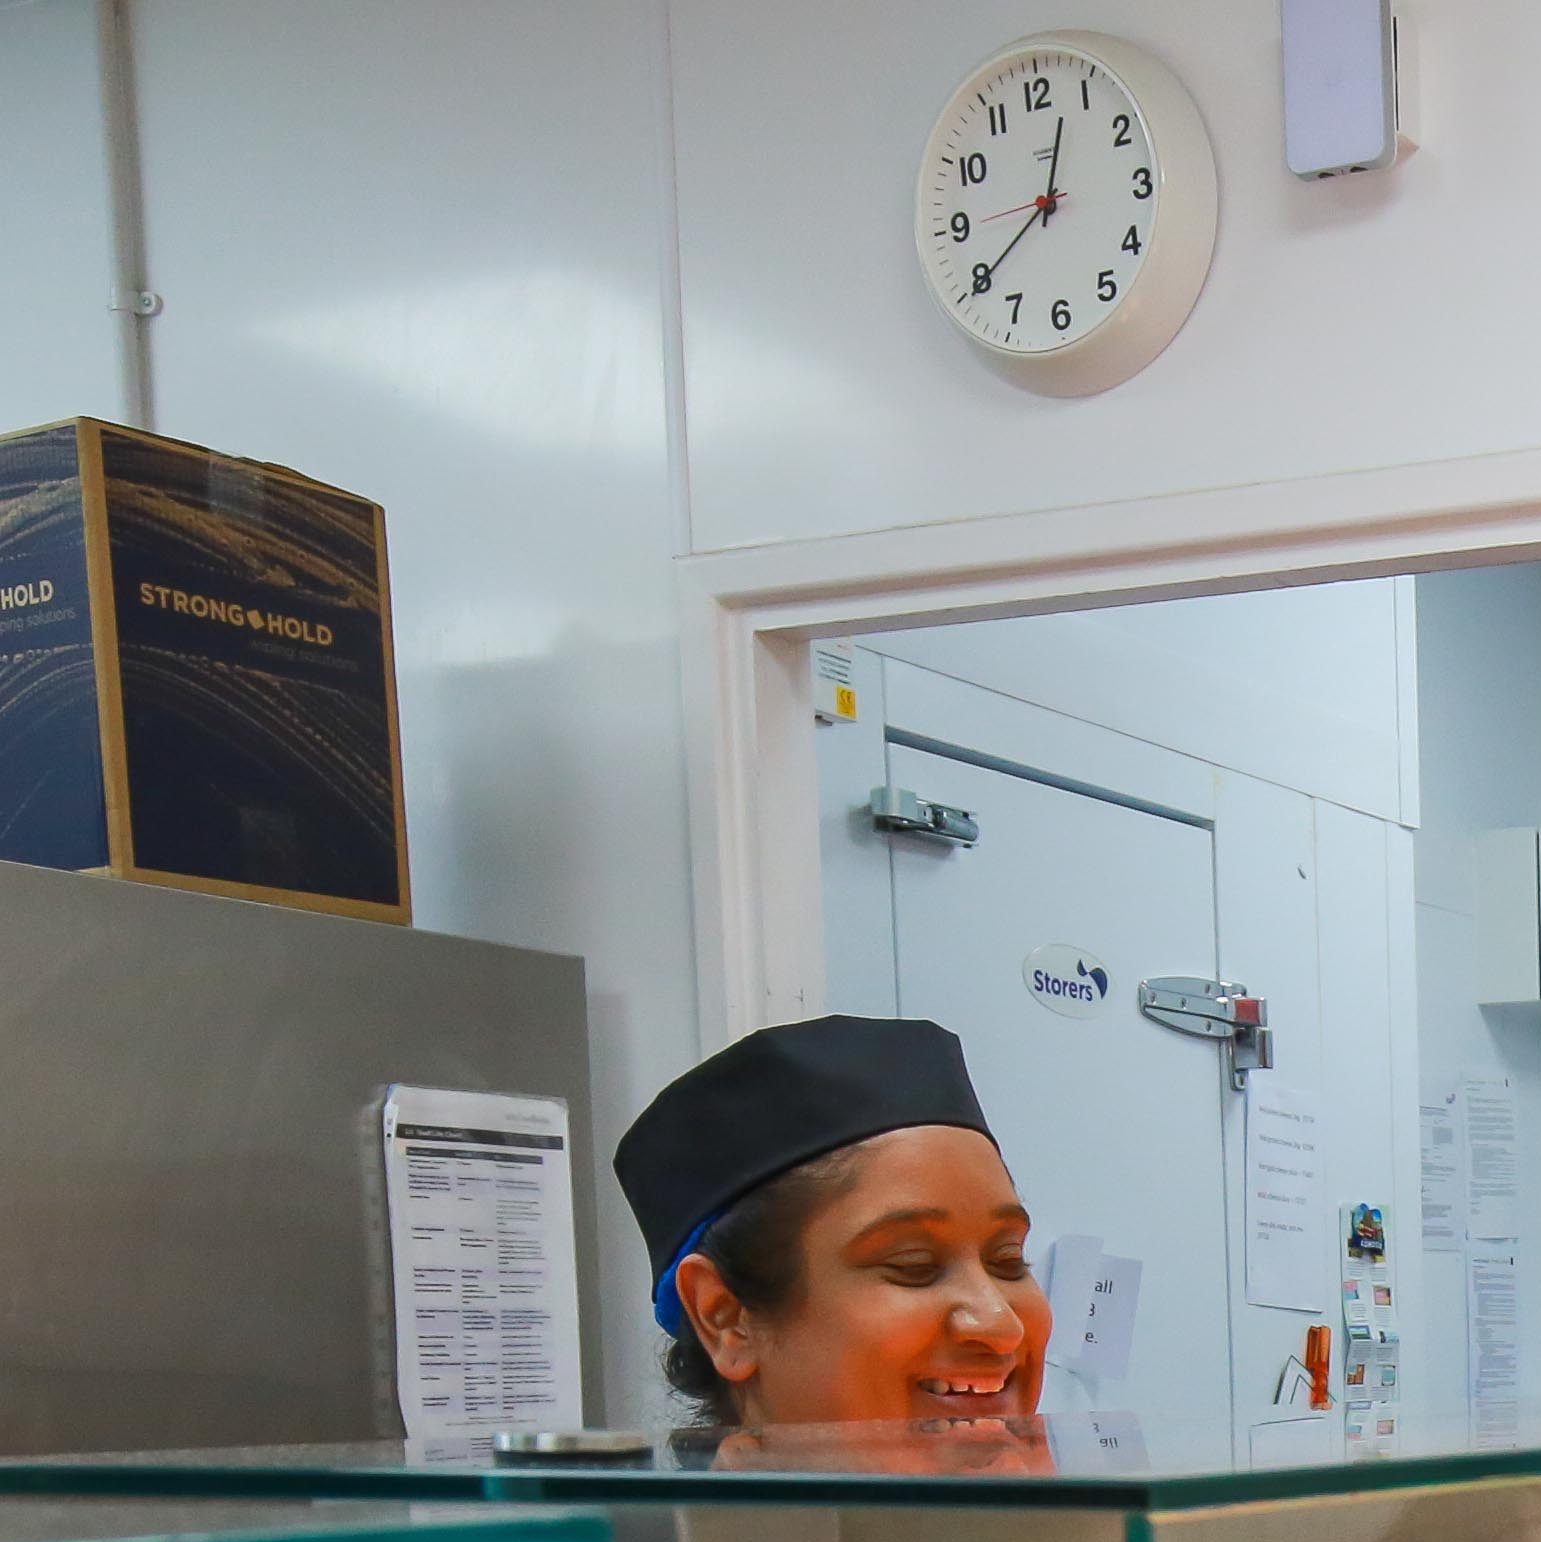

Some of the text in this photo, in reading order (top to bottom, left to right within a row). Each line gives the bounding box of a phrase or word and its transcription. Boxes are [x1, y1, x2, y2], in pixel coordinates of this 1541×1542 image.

[1024, 78, 1051, 112] 12
[1081, 80, 1089, 110] 1
[989, 103, 1007, 136] 11
[1112, 114, 1132, 147] 2
[960, 152, 986, 186] 10
[1132, 167, 1152, 199] 3
[951, 212, 969, 242] 9
[1121, 225, 1141, 255] 4
[972, 263, 992, 293] 8
[1097, 270, 1117, 301] 5
[1005, 292, 1023, 324] 7
[1051, 300, 1071, 330] 6
[139, 581, 333, 647] STRONG HOLD
[1034, 968, 1093, 1002] Storers
